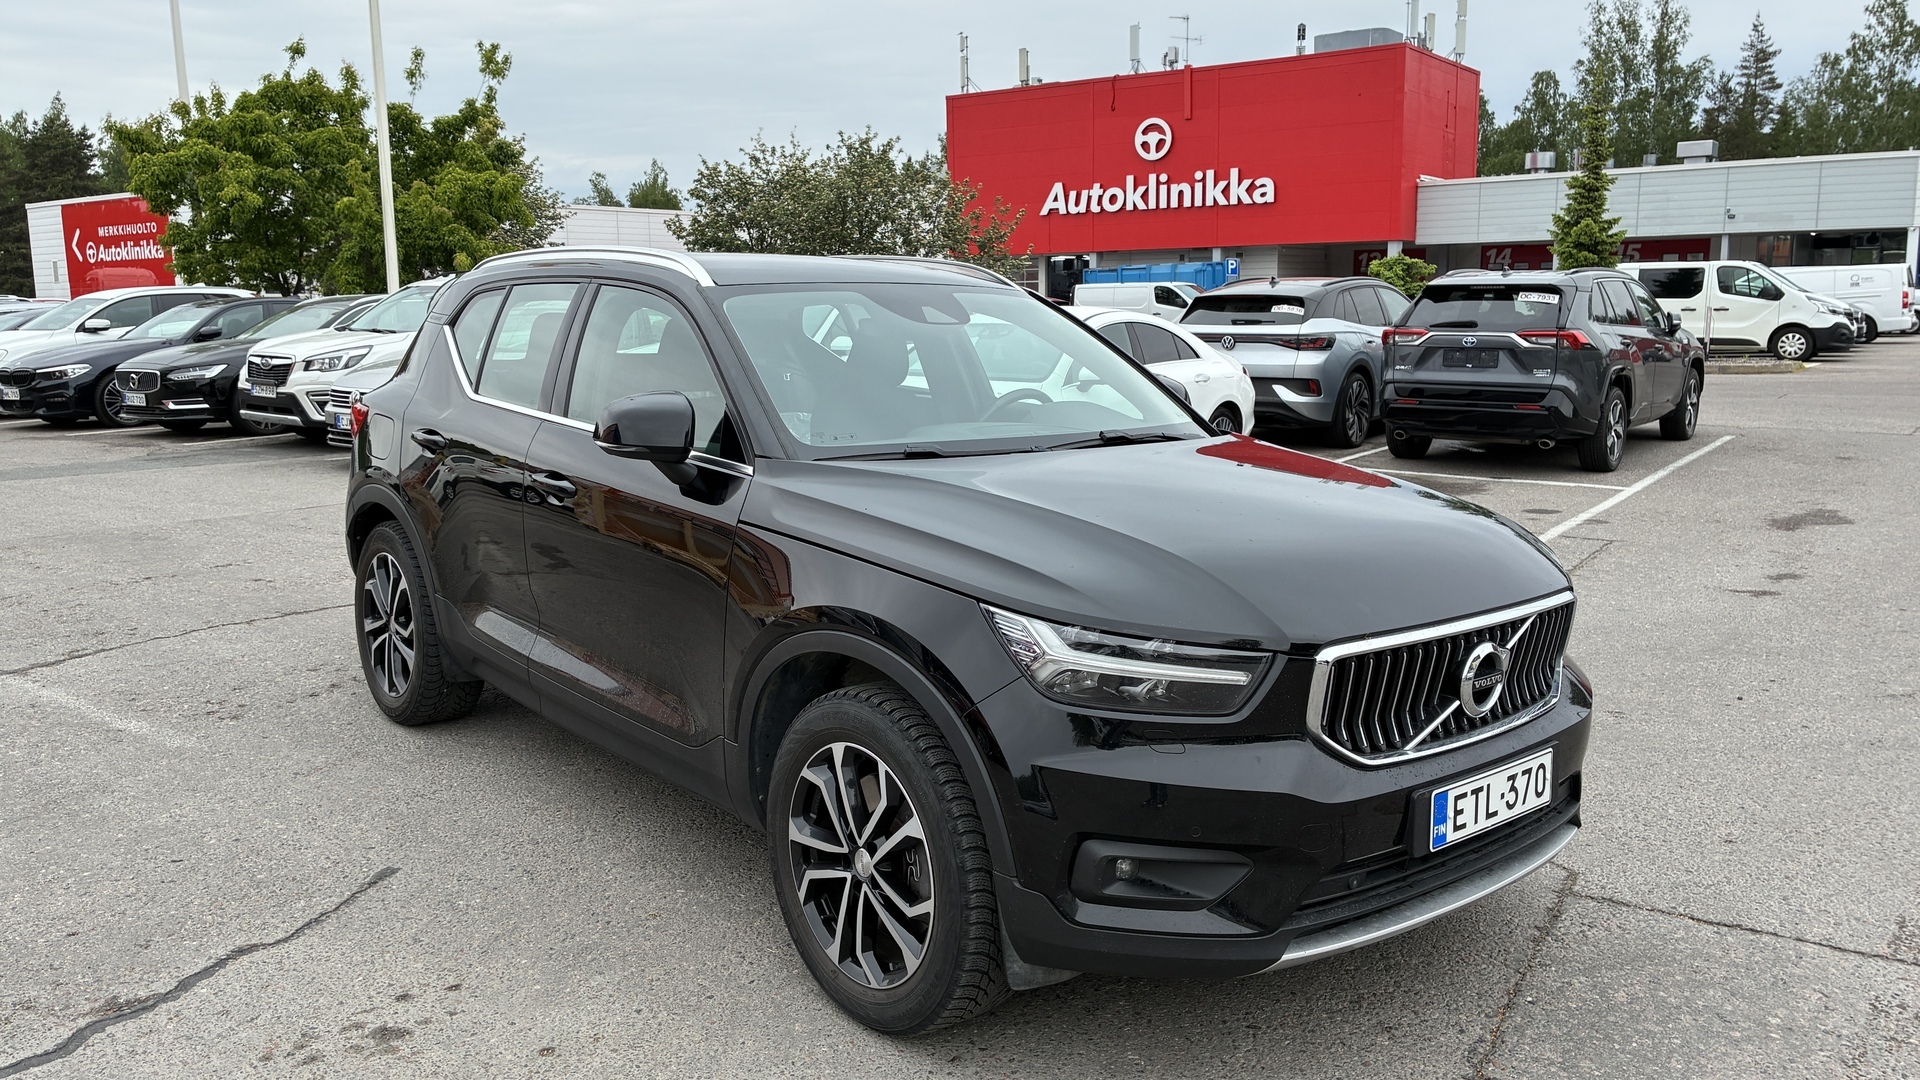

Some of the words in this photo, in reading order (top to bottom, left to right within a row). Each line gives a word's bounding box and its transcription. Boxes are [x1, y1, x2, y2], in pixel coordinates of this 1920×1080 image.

[1039, 167, 1275, 216] Autoklinikka
[97, 221, 157, 237] MERKKIHUOLTO
[97, 238, 165, 262] Autoklinikka
[1486, 248, 1512, 267] 14
[1228, 259, 1237, 274] P
[1473, 674, 1503, 689] VOLVO
[1452, 762, 1547, 834] ETL-370
[1433, 822, 1447, 838] FIN
